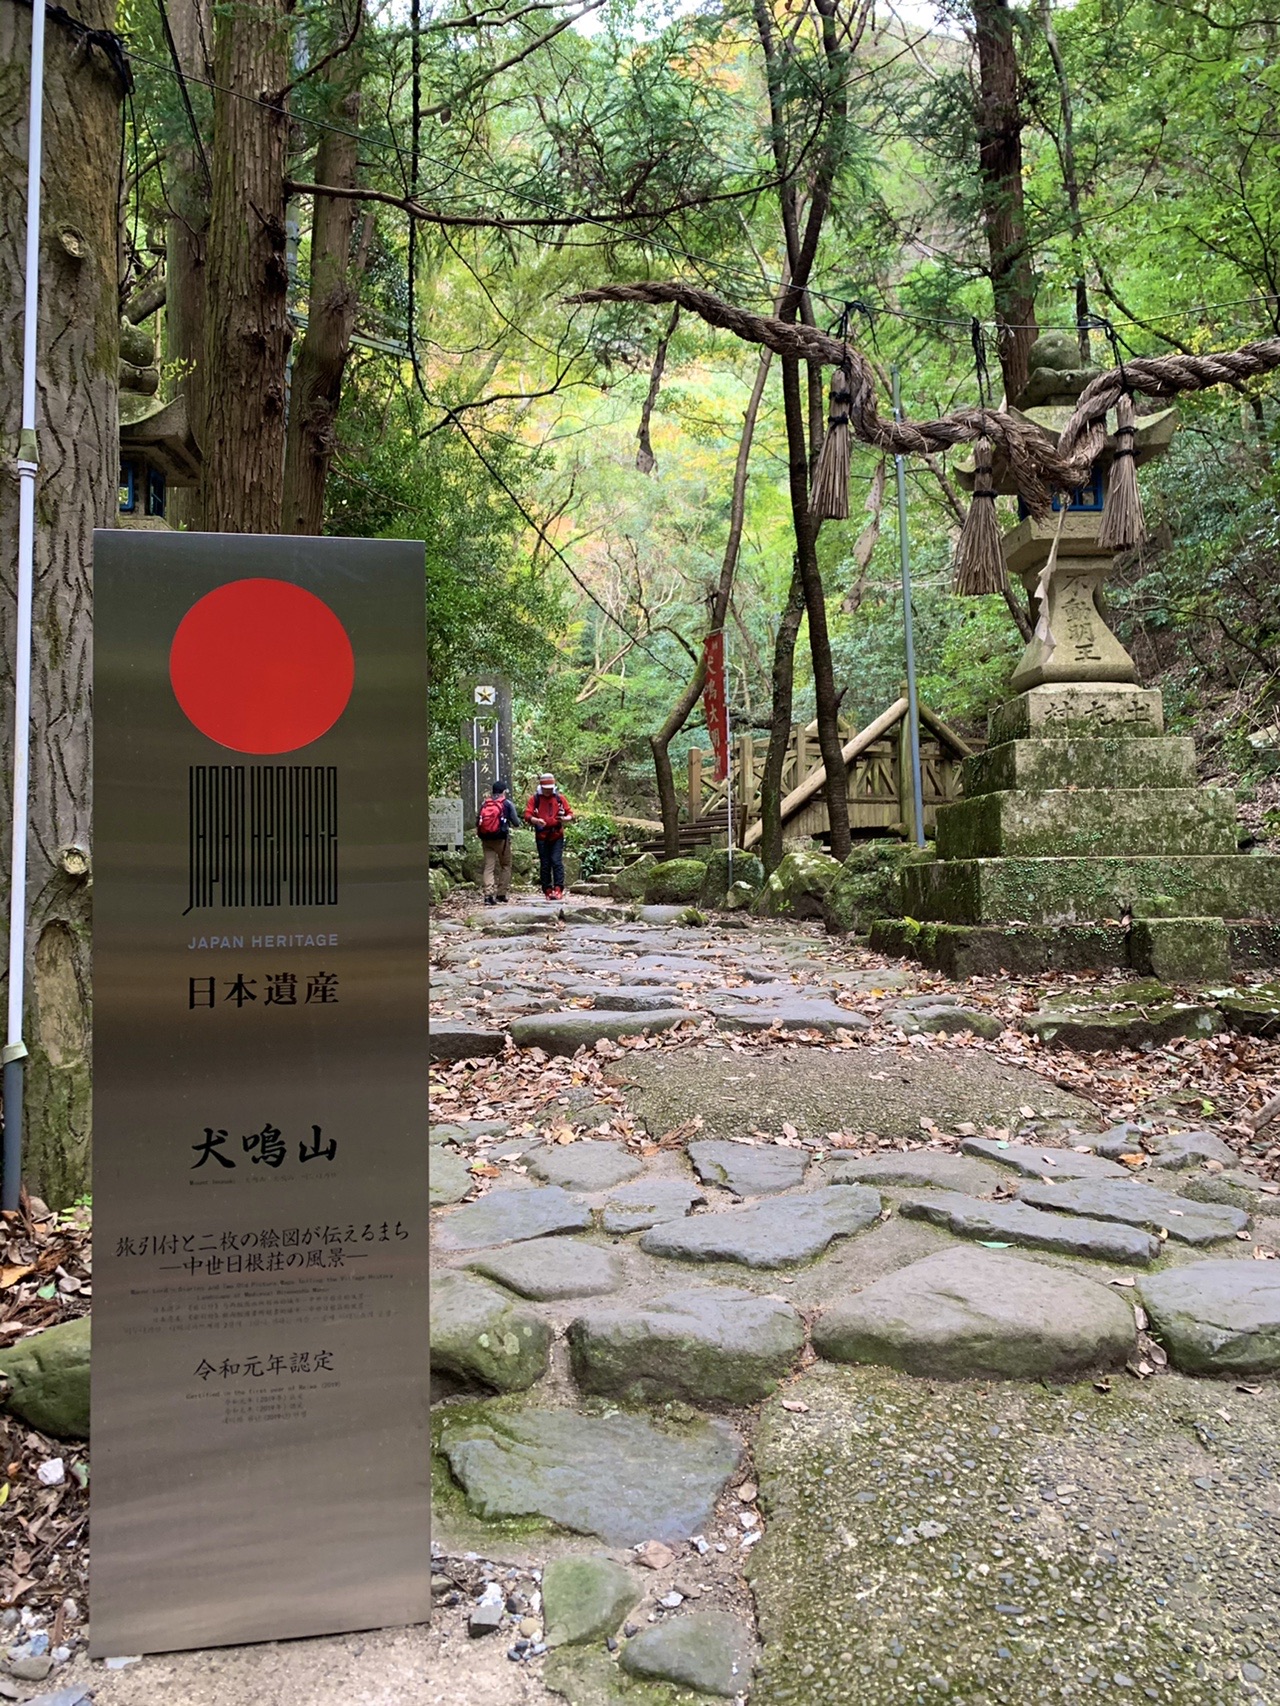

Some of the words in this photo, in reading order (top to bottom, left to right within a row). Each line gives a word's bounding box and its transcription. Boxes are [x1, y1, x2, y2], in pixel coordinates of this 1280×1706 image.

[187, 935, 245, 950] JAPAN
[251, 933, 339, 949] HERITAGE
[188, 971, 340, 1010] 日本遺産
[190, 1123, 338, 1170] 犬鳴山
[116, 1220, 410, 1258] 旅引付と二枚の絵図が伝えるまち
[193, 1349, 335, 1381] 令和元年認定
